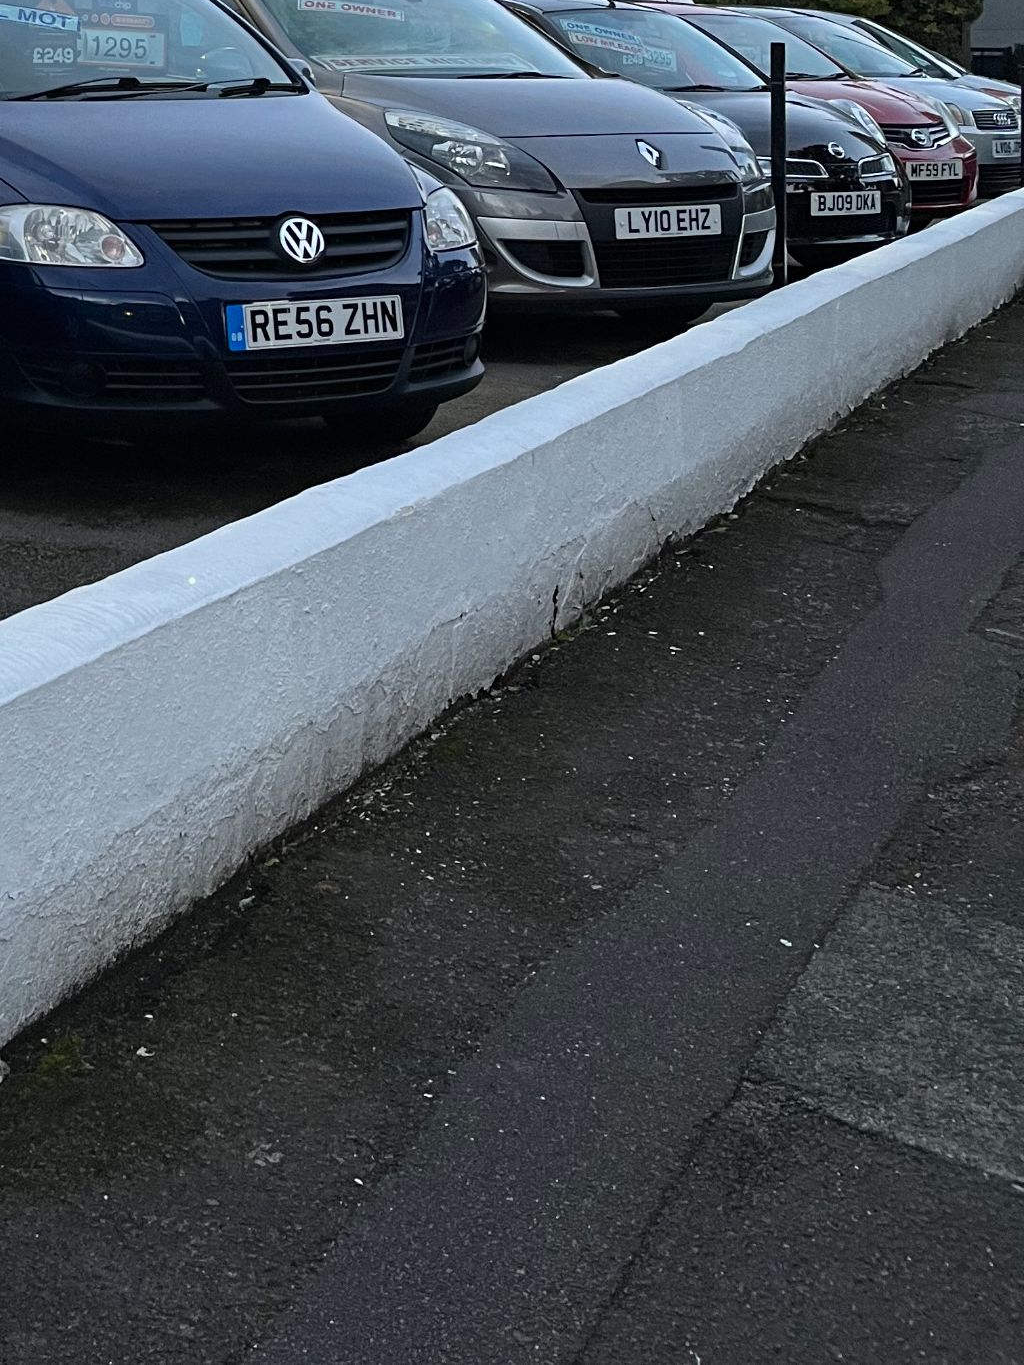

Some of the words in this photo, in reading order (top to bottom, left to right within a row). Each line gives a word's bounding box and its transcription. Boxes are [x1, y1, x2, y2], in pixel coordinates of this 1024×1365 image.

[17, 8, 73, 29] MOT
[304, 0, 337, 10] ONE
[341, 3, 396, 18] OWNER
[567, 21, 592, 32] ONE
[595, 26, 637, 42] OWNER
[576, 34, 598, 45] LOW
[32, 47, 75, 65] £249
[77, 35, 148, 60] 1295
[329, 56, 419, 68] SERVICE
[911, 163, 939, 177] MF59
[941, 161, 959, 176] FYL
[817, 194, 853, 213] BJ09
[856, 193, 876, 211] DKA
[627, 209, 672, 234] LY10
[677, 208, 711, 232] EHZ
[250, 305, 334, 343] RE56
[342, 300, 399, 336] ZHN
